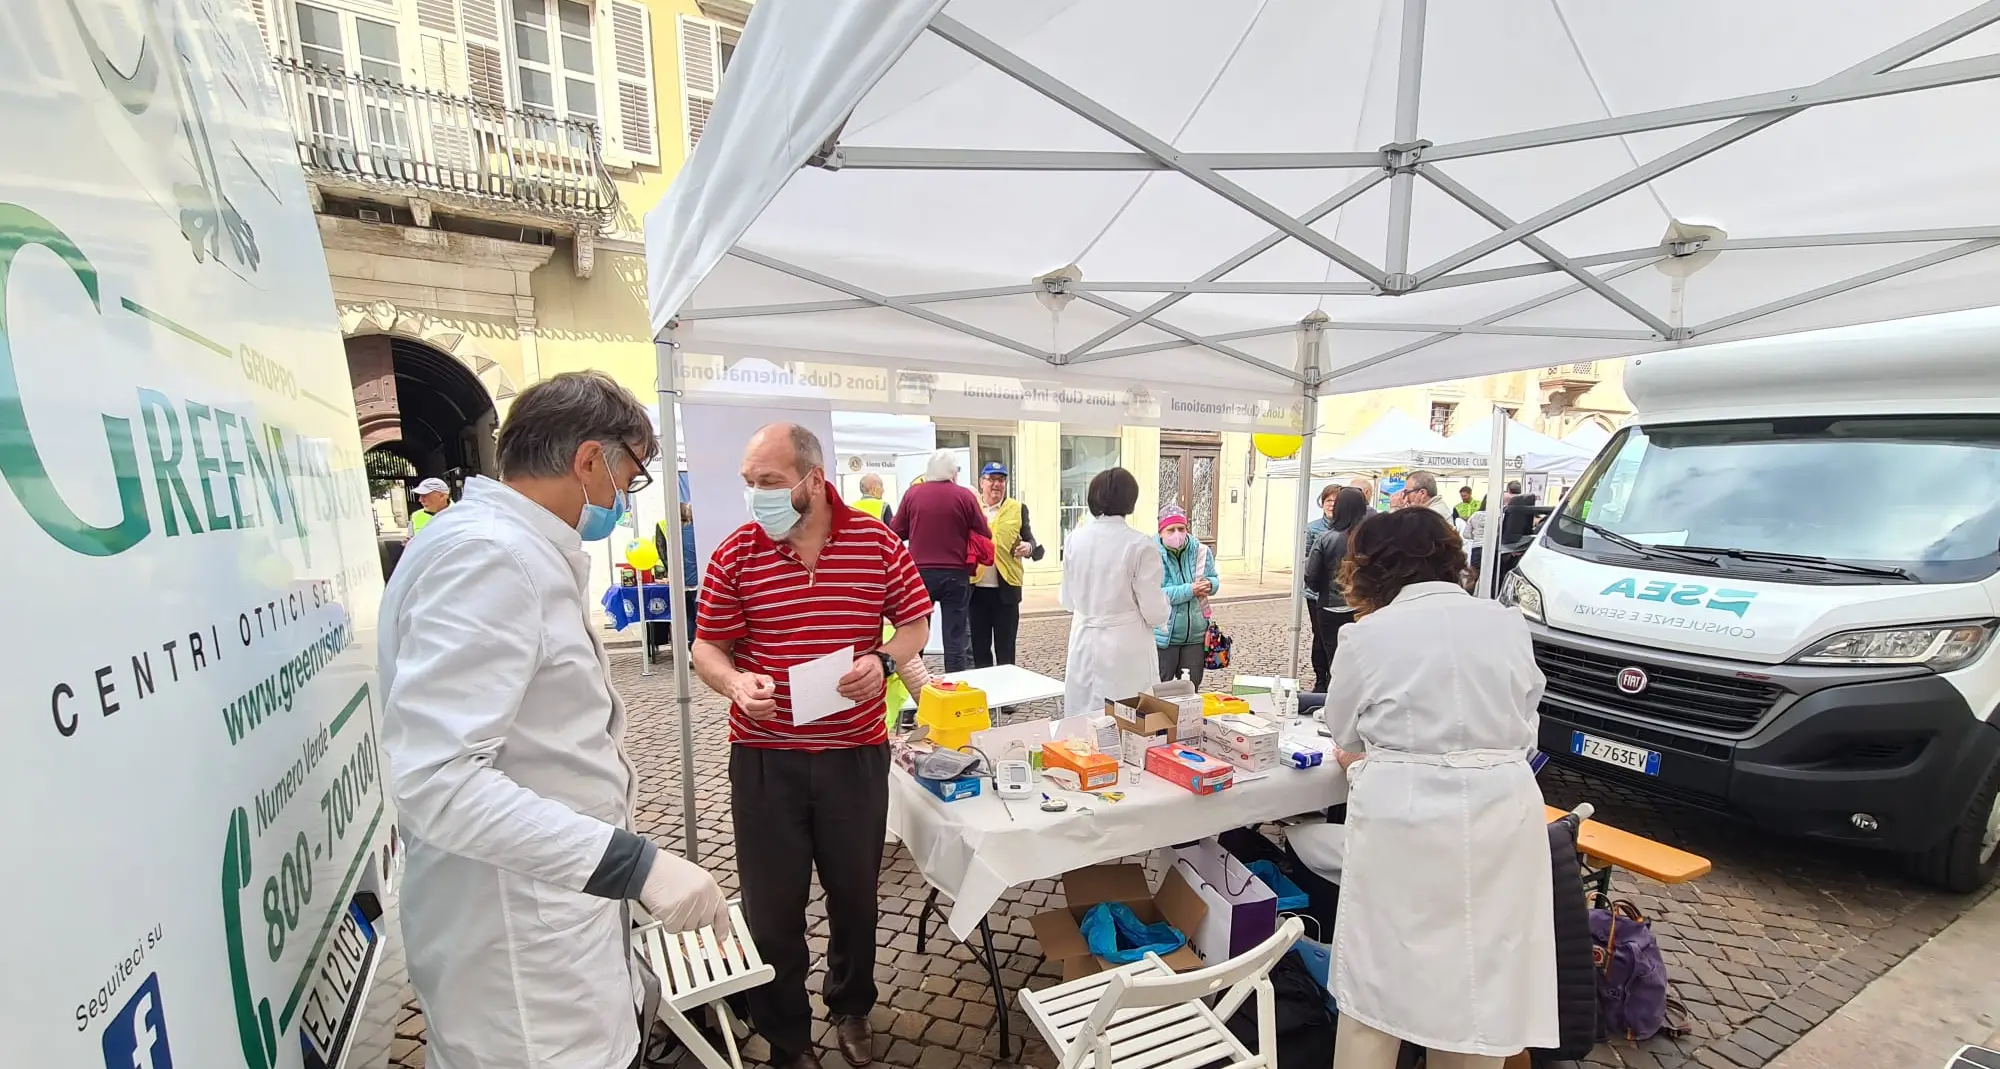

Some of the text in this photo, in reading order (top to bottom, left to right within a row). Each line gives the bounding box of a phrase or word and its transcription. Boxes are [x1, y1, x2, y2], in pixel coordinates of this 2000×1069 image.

[240, 343, 298, 400] GRUPPO
[1427, 456, 1488, 467] AUTOMOBILE CLUB
[51, 623, 222, 738] CENTRI
[239, 590, 306, 647] OTTICI
[222, 612, 355, 747] www.greenvision.it
[1623, 674, 1641, 688] FIAT
[254, 721, 329, 838] Numero Verde
[76, 923, 163, 1033] Seguiteci su
